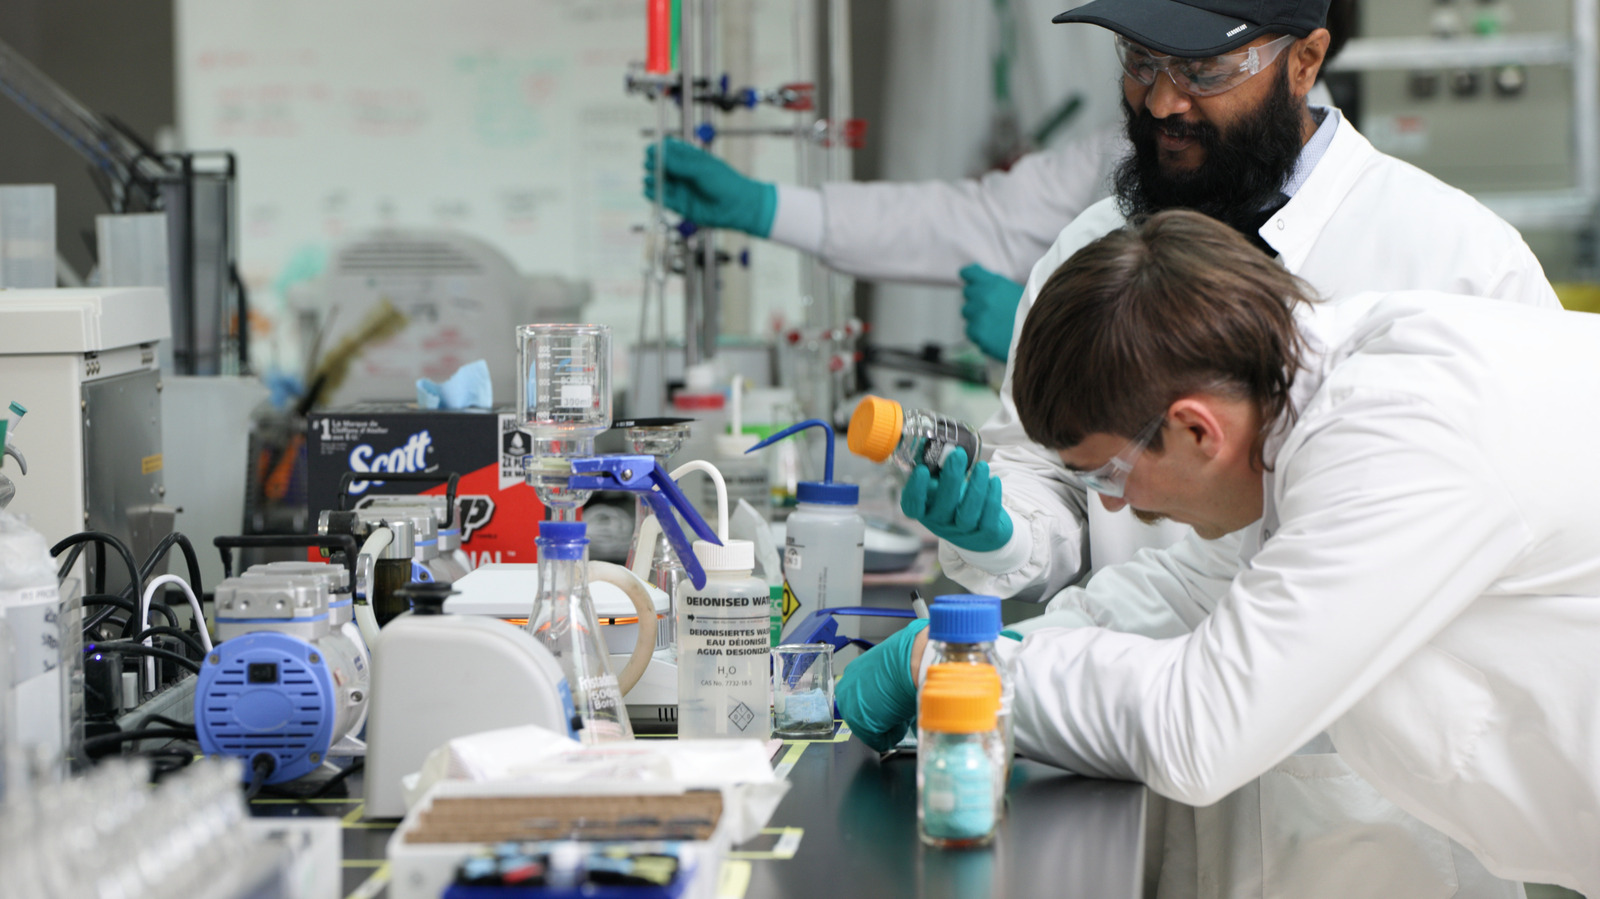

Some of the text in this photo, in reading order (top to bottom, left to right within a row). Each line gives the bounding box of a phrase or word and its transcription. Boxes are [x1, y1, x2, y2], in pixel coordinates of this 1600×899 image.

[348, 430, 432, 494] Scott
[686, 595, 750, 608] DEIONISED
[689, 628, 755, 637] DEIONISIERTES
[706, 638, 726, 647] EAU
[697, 648, 723, 656] AGUA
[700, 679, 713, 687] CAS
